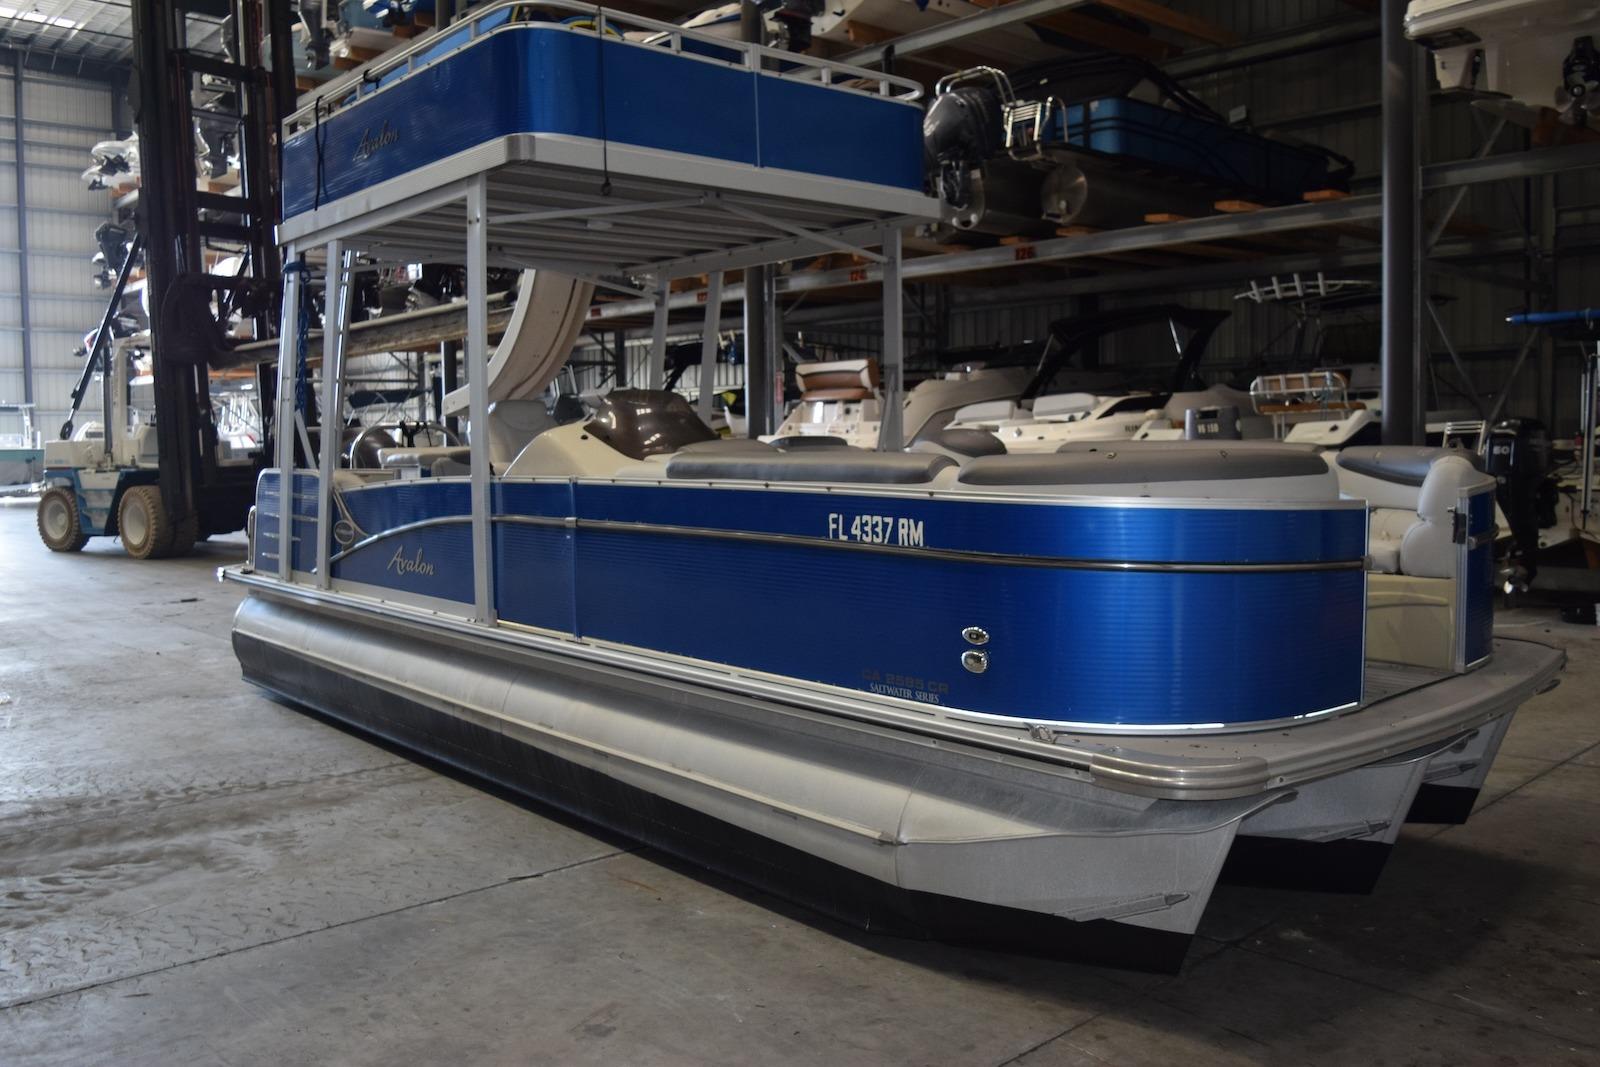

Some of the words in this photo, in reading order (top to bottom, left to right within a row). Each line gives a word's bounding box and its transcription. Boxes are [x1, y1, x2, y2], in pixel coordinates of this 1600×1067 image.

[353, 119, 399, 161] Avalon
[828, 512, 849, 541] FL
[850, 514, 894, 545] 4337
[898, 517, 925, 548] RM
[386, 543, 435, 576] Avalon
[869, 682, 913, 699] SALTWATER
[914, 690, 940, 704] SERIES
